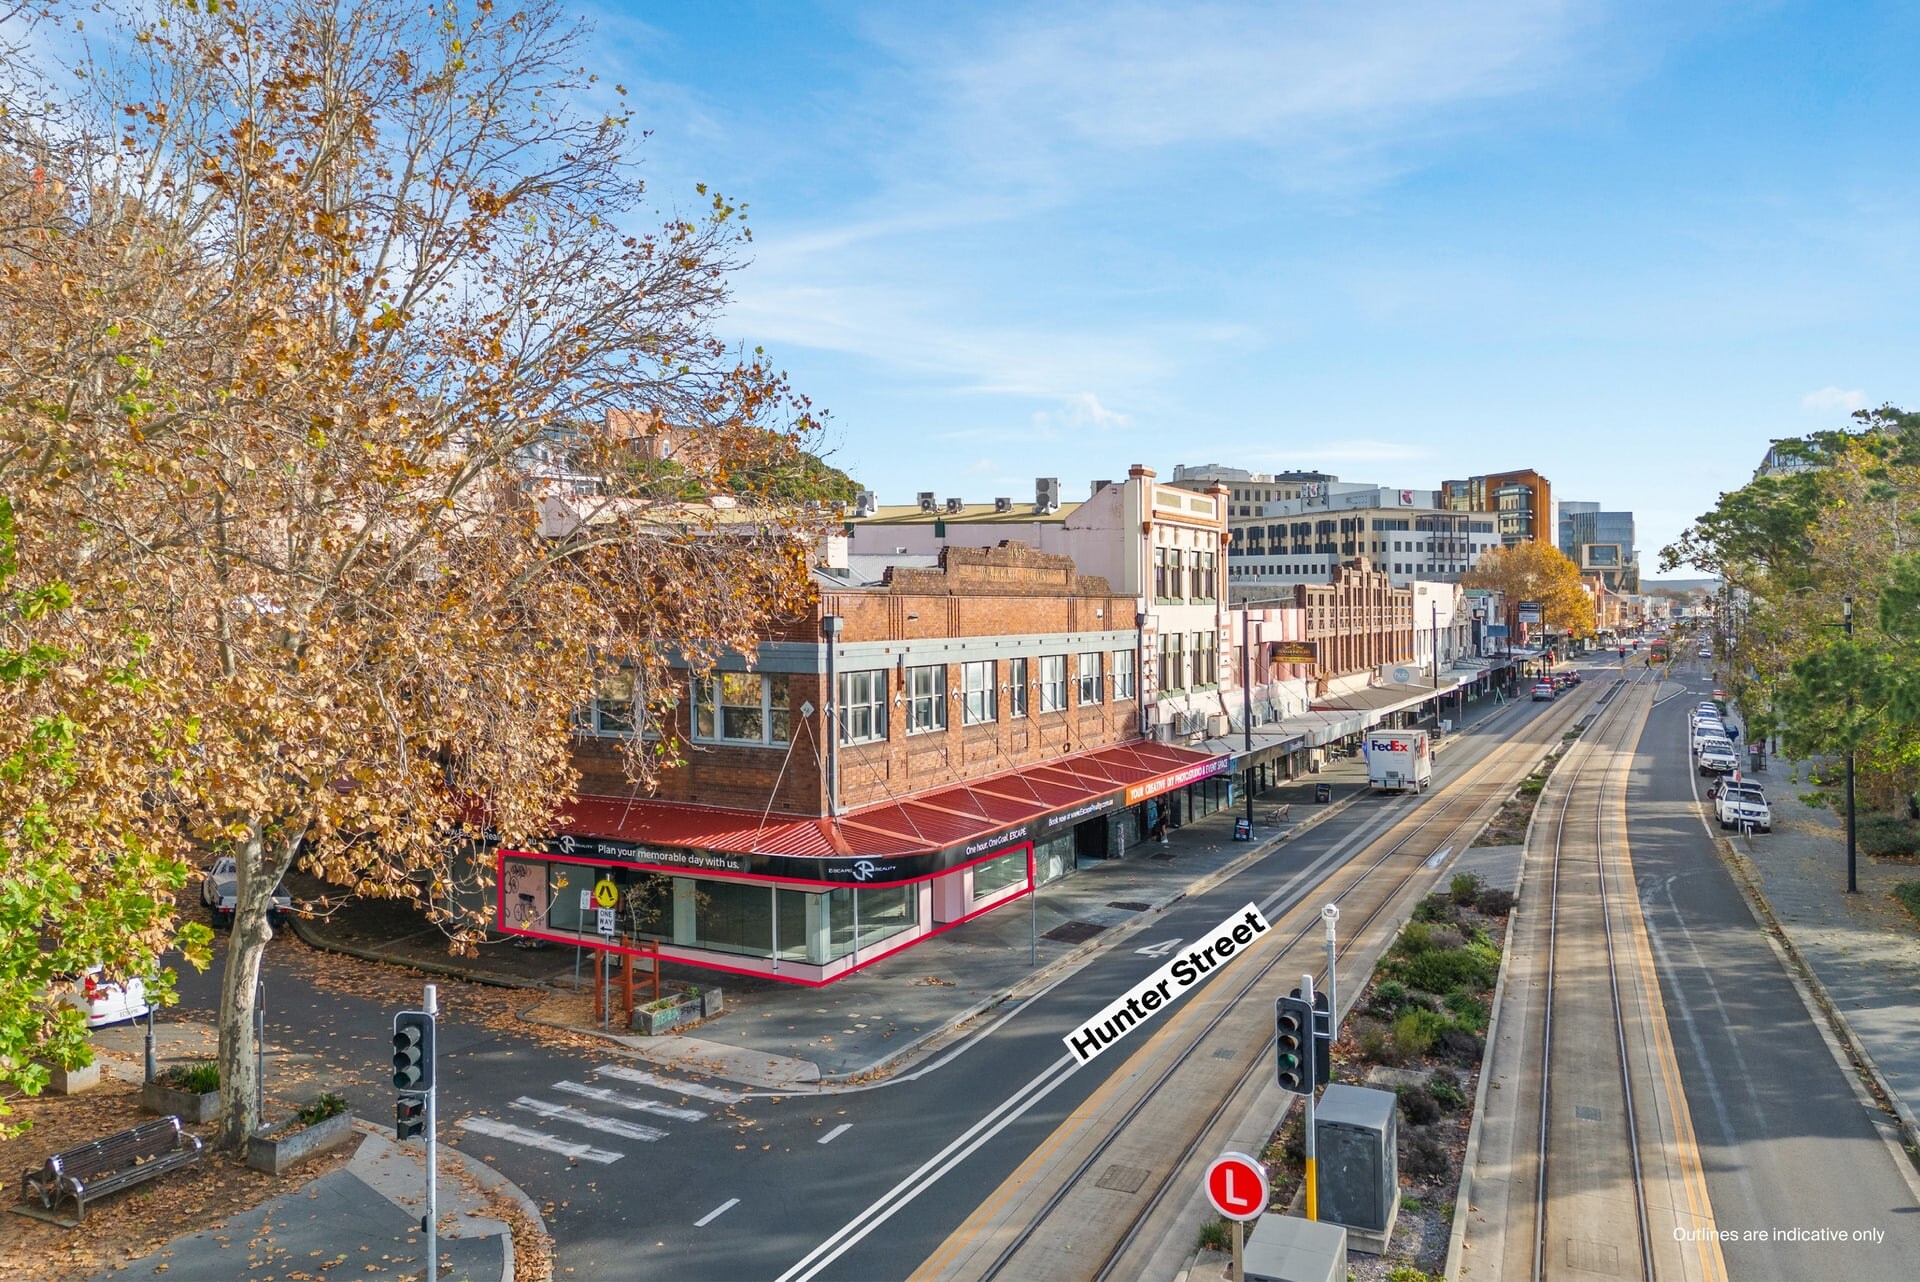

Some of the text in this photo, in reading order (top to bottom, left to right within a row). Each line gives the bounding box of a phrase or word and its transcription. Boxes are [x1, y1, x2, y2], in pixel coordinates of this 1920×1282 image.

[1371, 740, 1408, 752] FedEx
[1131, 786, 1144, 800] YOUR
[1145, 779, 1166, 795] CREATIVE
[1206, 762, 1217, 774] EVENT
[1217, 759, 1228, 770] SPACE
[1049, 816, 1059, 826] Book
[965, 846, 977, 856] One
[988, 838, 999, 848] One
[598, 844, 740, 869] Plan your memorable day with us.
[600, 910, 612, 918] ONE
[1226, 1168, 1248, 1207] L
